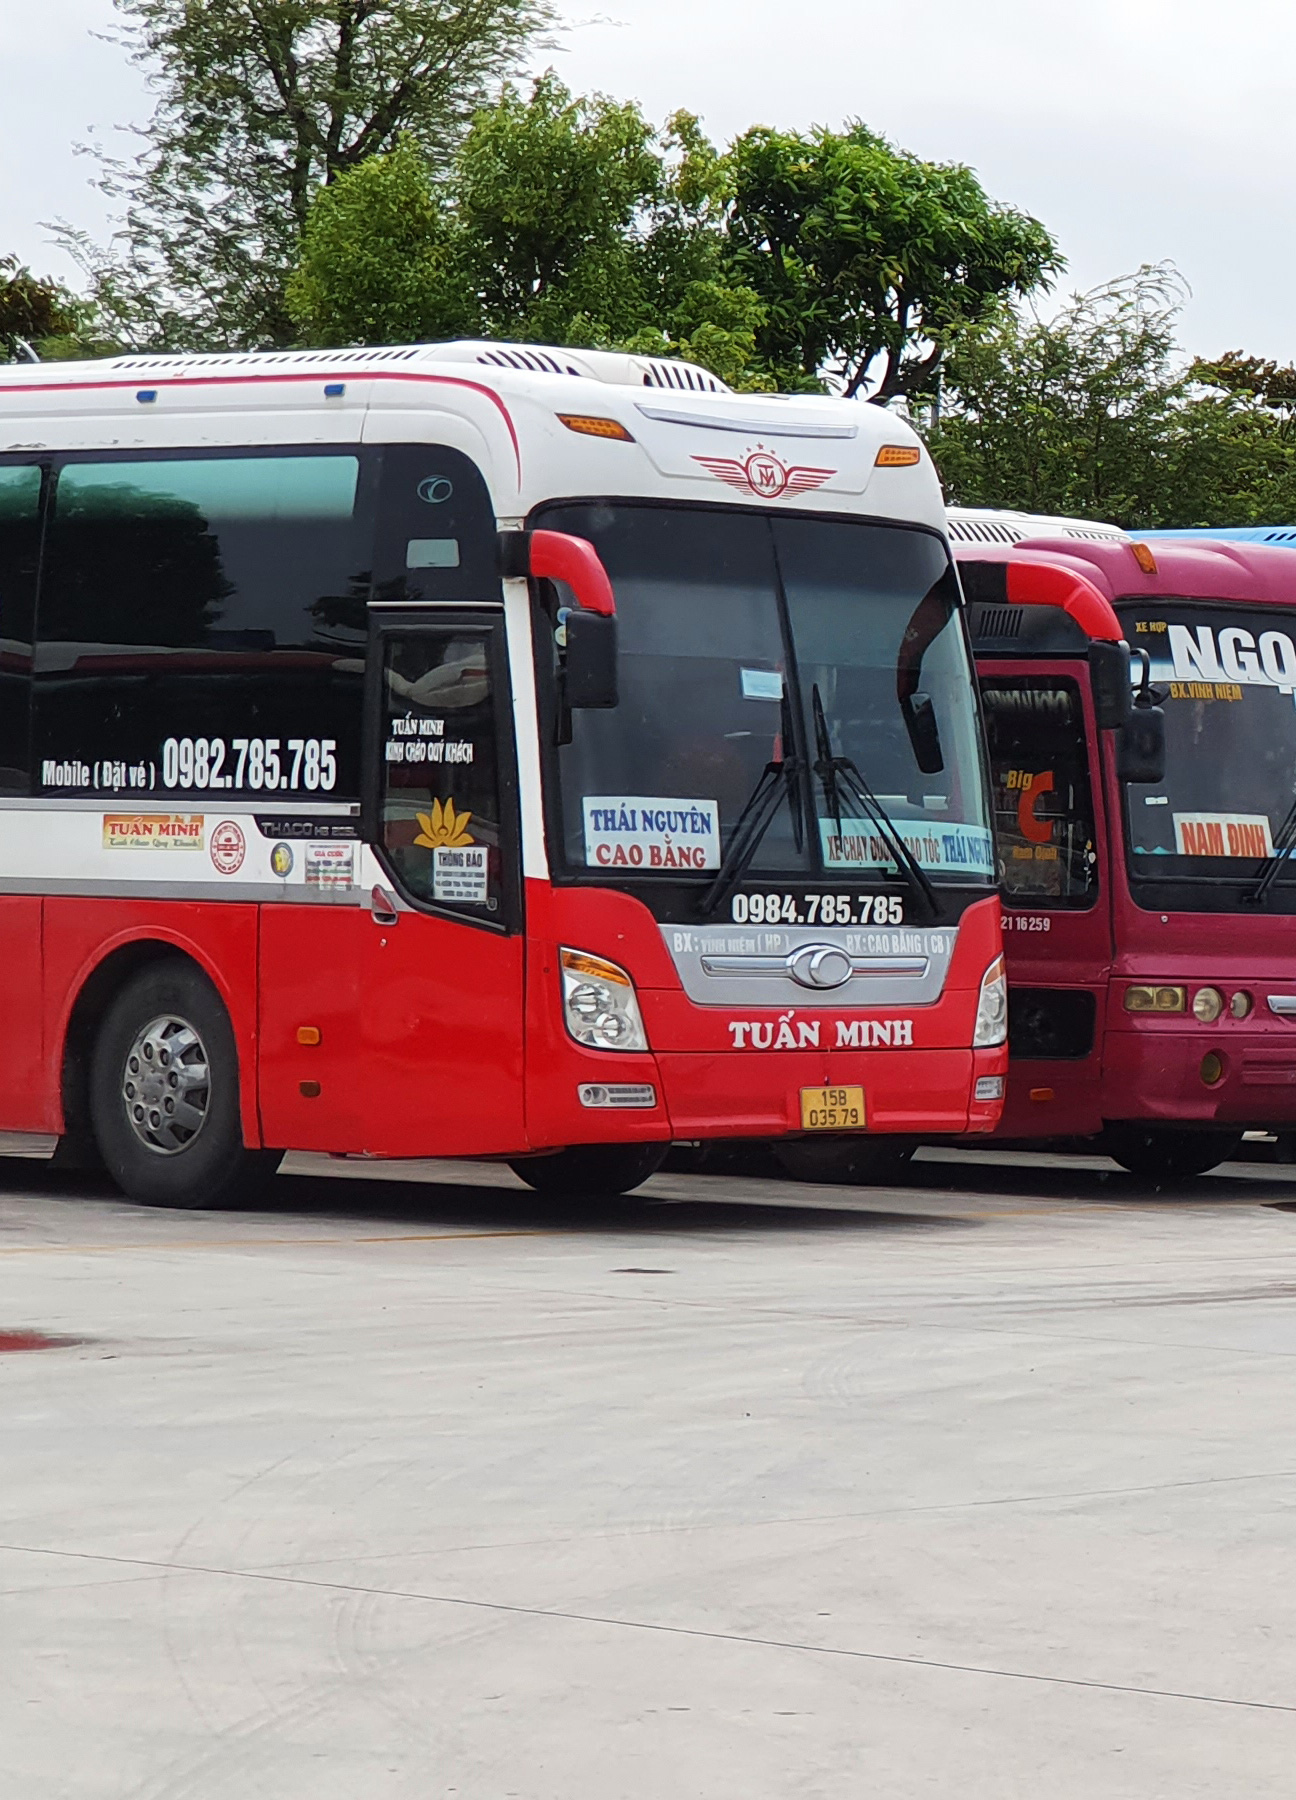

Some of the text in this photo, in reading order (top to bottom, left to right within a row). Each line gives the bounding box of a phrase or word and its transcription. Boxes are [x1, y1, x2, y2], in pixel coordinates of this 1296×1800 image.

[392, 711, 444, 736] TUẤN MINH
[42, 760, 90, 787] Mobile
[162, 737, 337, 790] 0982.785.785
[1006, 770, 1033, 790] Big
[590, 802, 711, 834] THÁI NGUYÊN
[1018, 771, 1054, 843] C
[108, 817, 199, 836] TUẤN MINH
[261, 822, 313, 836] THACO
[1180, 823, 1223, 856] NAM
[596, 833, 707, 868] CAO BẰNG
[942, 828, 967, 864] THÁI
[732, 893, 903, 924] 0984.785.785
[728, 1010, 915, 1049] TUẤN MINH
[822, 1090, 847, 1106] 15B
[809, 1108, 859, 1126] 035.79
